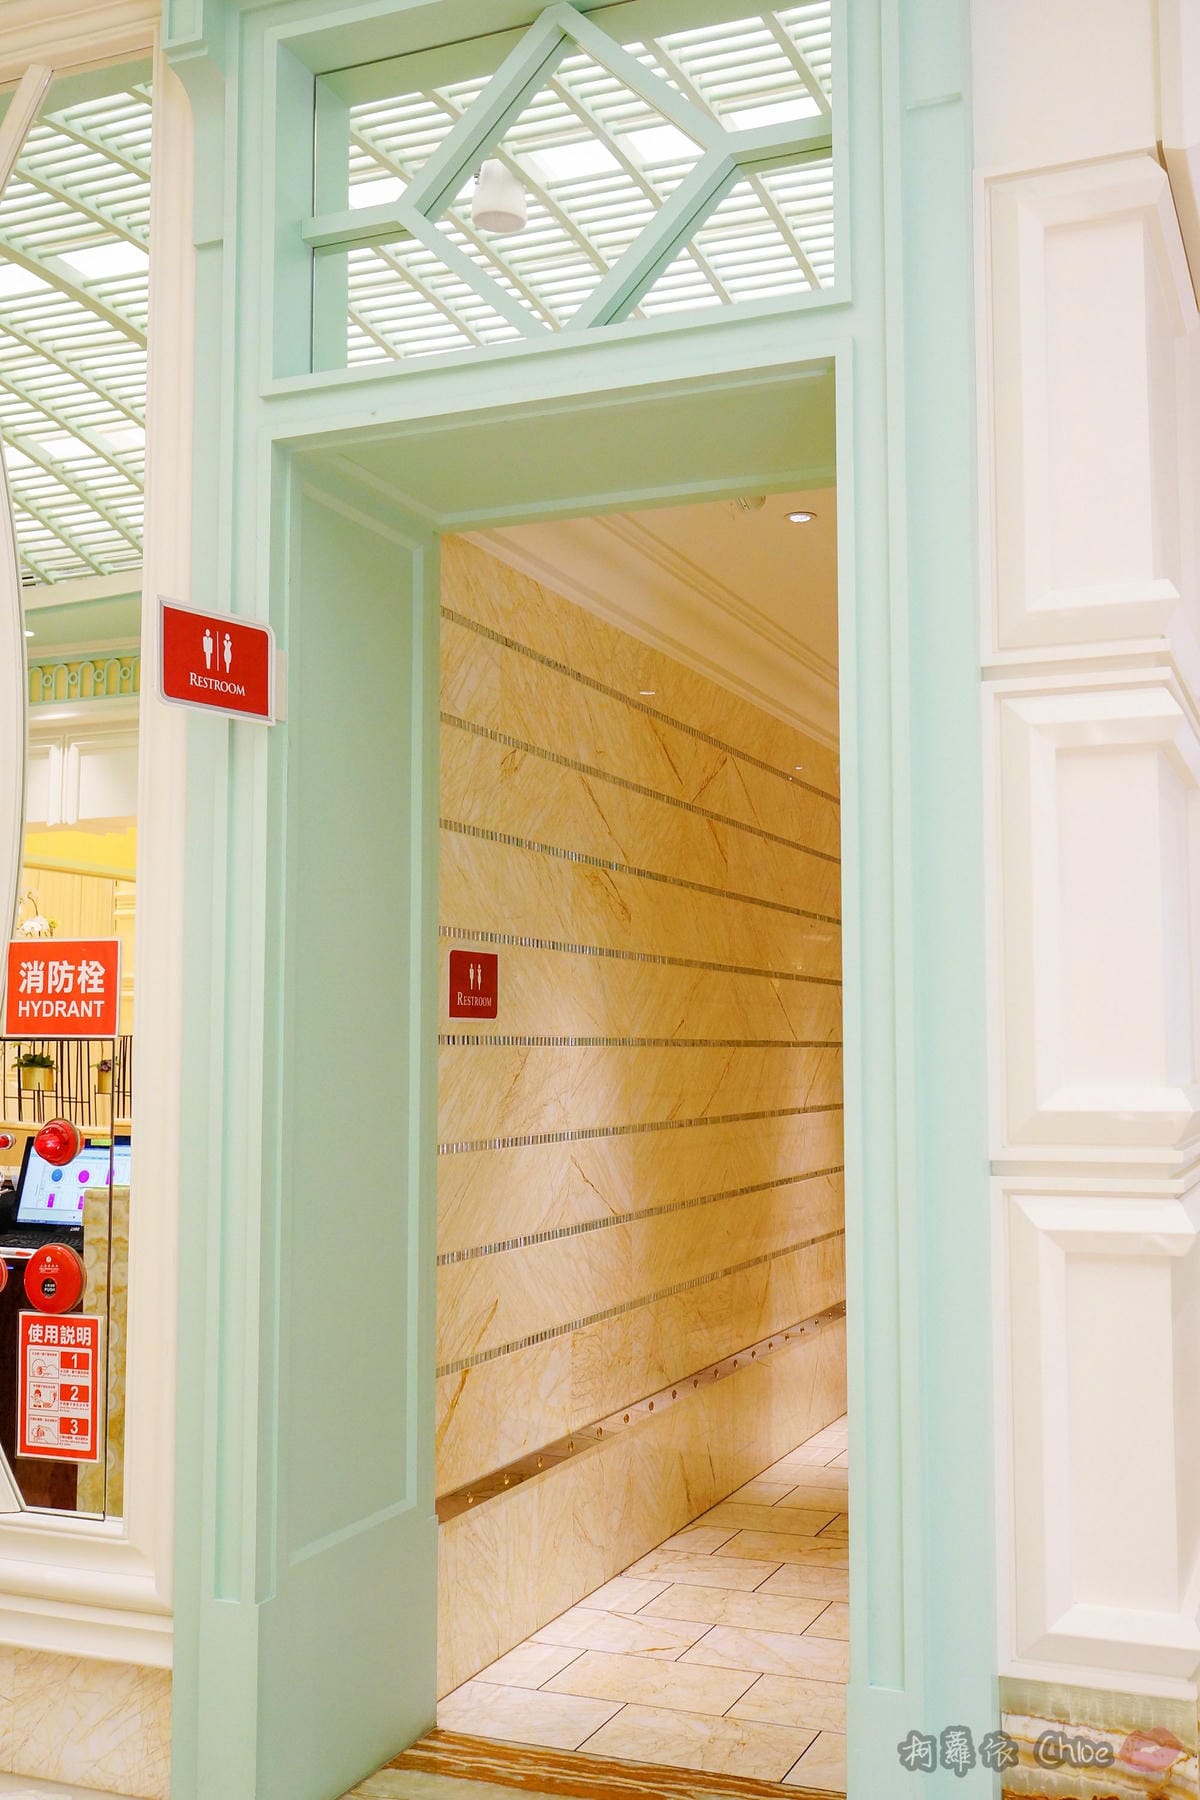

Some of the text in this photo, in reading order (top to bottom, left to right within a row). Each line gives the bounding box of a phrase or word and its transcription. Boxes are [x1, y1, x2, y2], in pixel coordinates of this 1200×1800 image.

[189, 672, 246, 696] RESTROOM
[18, 960, 106, 994] 消防栓
[457, 991, 492, 1007] RESTROOM
[18, 1000, 105, 1018] HYDRANT
[71, 1353, 78, 1369] 1
[70, 1385, 79, 1401] 2
[70, 1418, 79, 1435] 3
